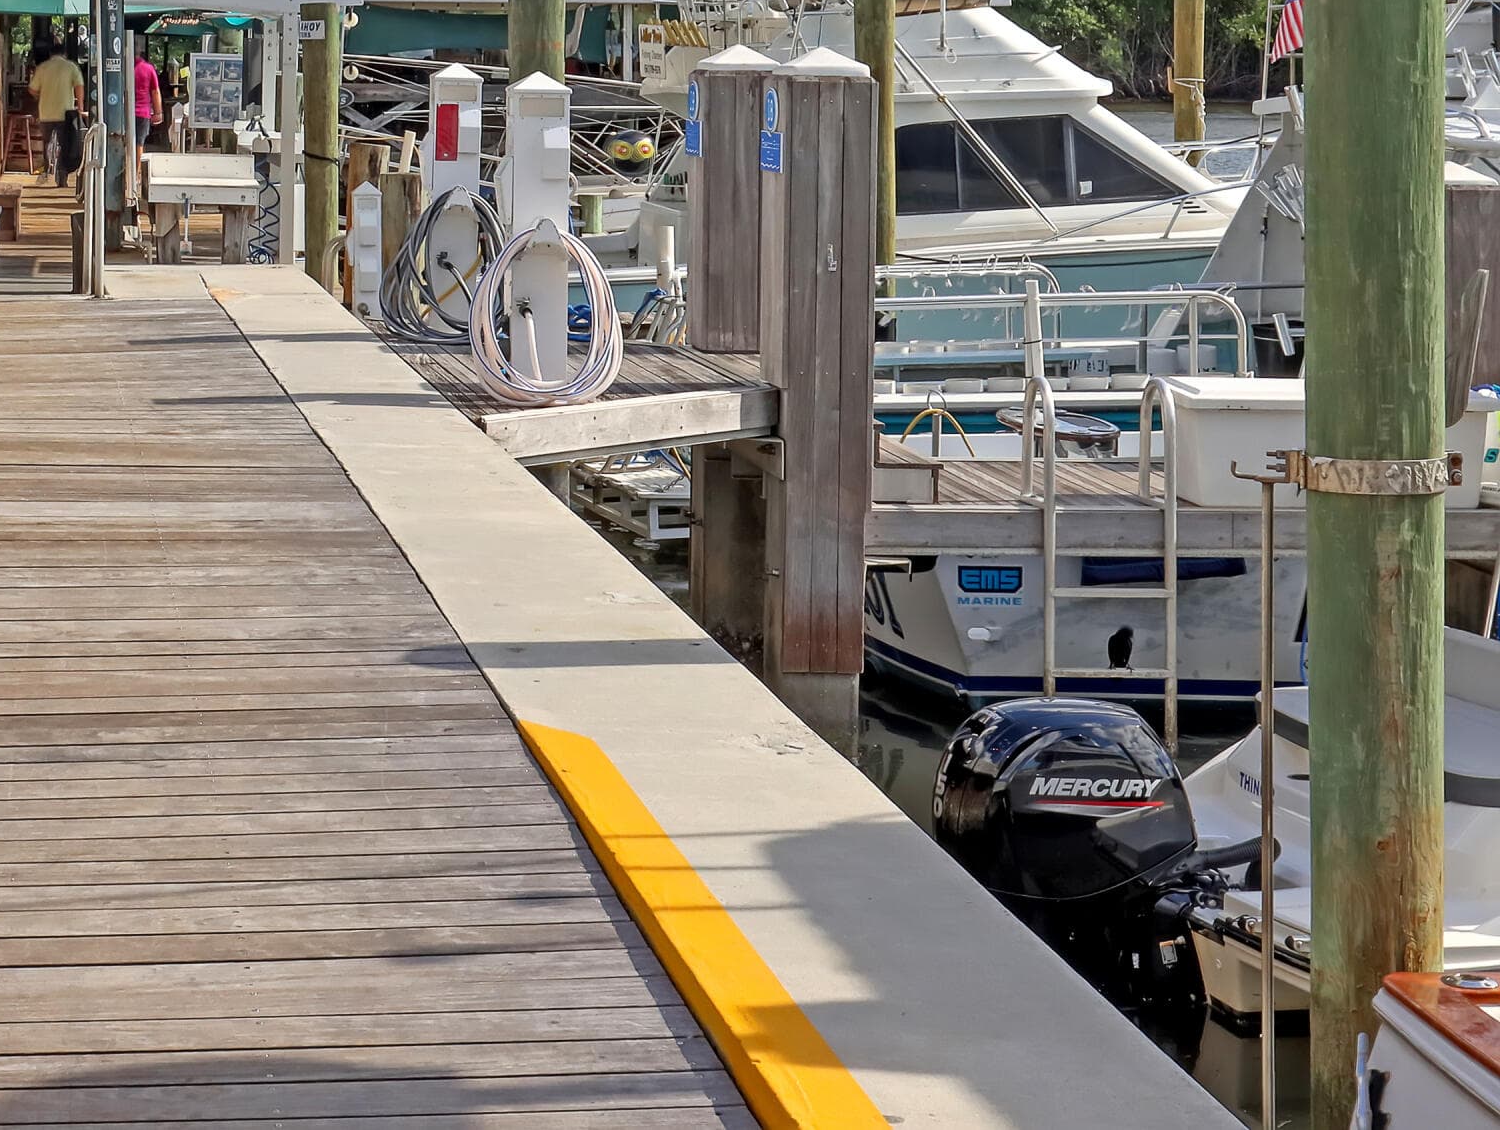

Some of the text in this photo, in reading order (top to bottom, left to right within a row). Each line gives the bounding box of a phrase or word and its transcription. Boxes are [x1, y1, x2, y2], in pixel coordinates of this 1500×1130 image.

[960, 570, 1021, 591] EMS
[957, 597, 1022, 606] MARINE
[1029, 778, 1162, 798] MERCURY
